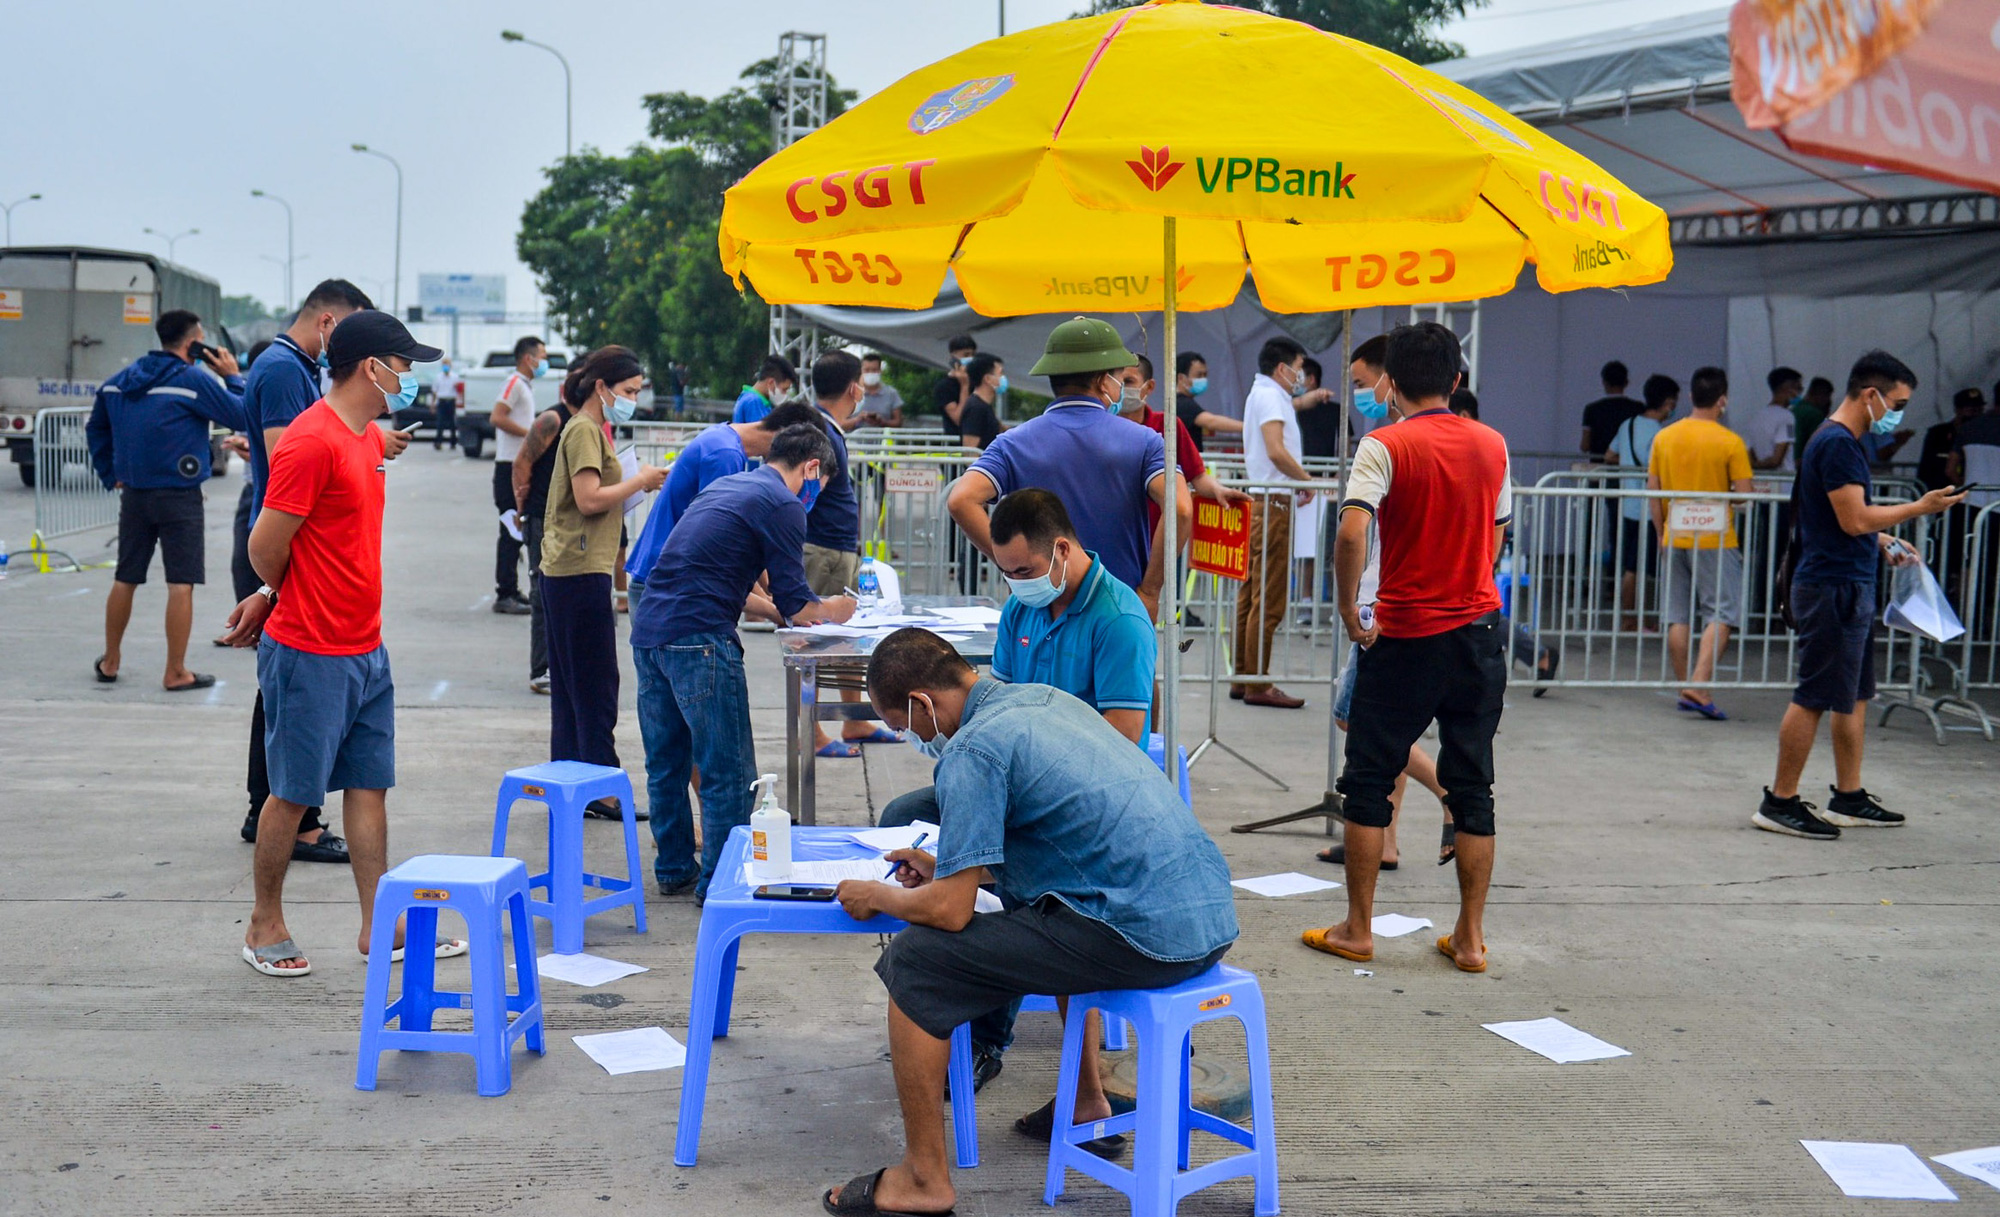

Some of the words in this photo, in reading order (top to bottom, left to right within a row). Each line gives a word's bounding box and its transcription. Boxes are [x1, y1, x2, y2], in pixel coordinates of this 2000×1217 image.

[785, 158, 938, 224] CSGT
[1196, 157, 1357, 199] VPBank
[1539, 170, 1627, 231] CSGT
[1198, 502, 1220, 529] KHU
[1222, 506, 1242, 536] VỰC
[1681, 516, 1715, 526] STOP
[1193, 538, 1210, 564] KHAI
[1211, 540, 1227, 568] BÁO
[1228, 546, 1234, 569] Y
[1235, 541, 1245, 571] TẾ
